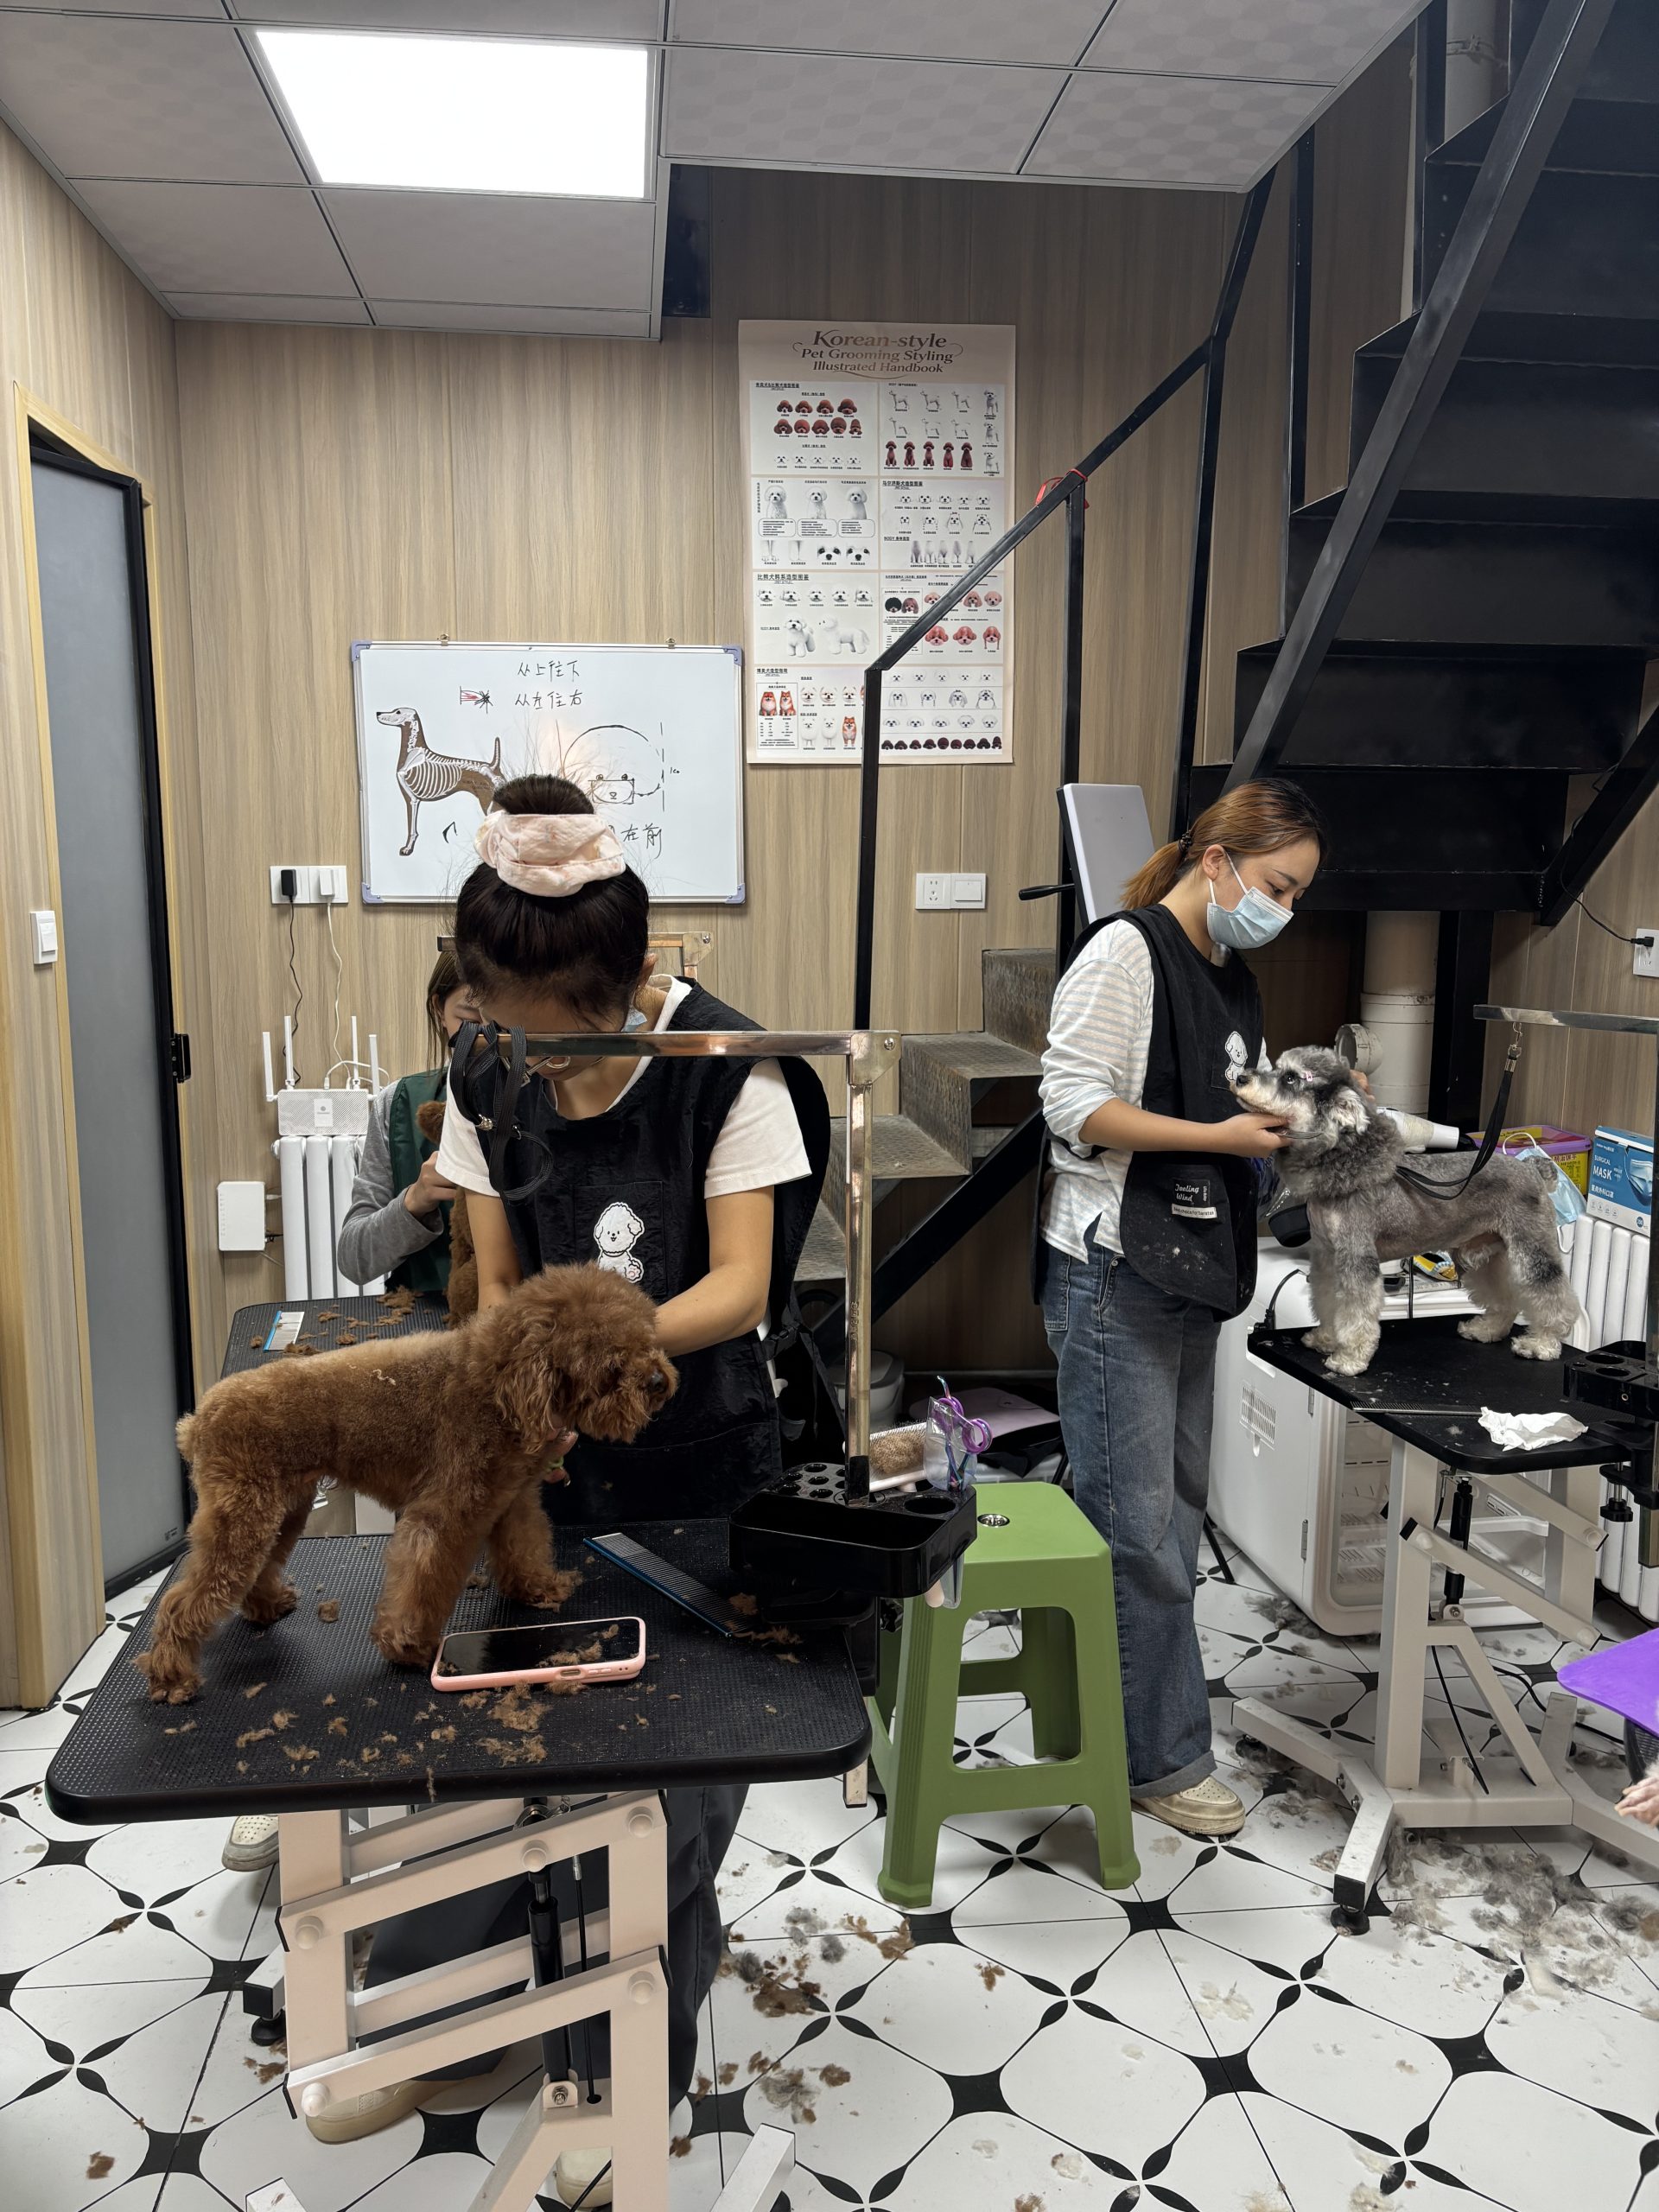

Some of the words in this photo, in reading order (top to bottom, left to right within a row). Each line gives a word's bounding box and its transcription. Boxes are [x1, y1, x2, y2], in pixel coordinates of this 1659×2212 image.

[813, 330, 947, 351] Korean-style
[802, 348, 823, 359] Pet
[829, 349, 900, 363] Grooming
[903, 350, 954, 364] Styling
[813, 361, 876, 372] Illustrated
[880, 362, 944, 372] Handbook
[518, 660, 580, 683] 从上往下
[608, 823, 663, 859] 在前
[1593, 1165, 1612, 1180] MASK
